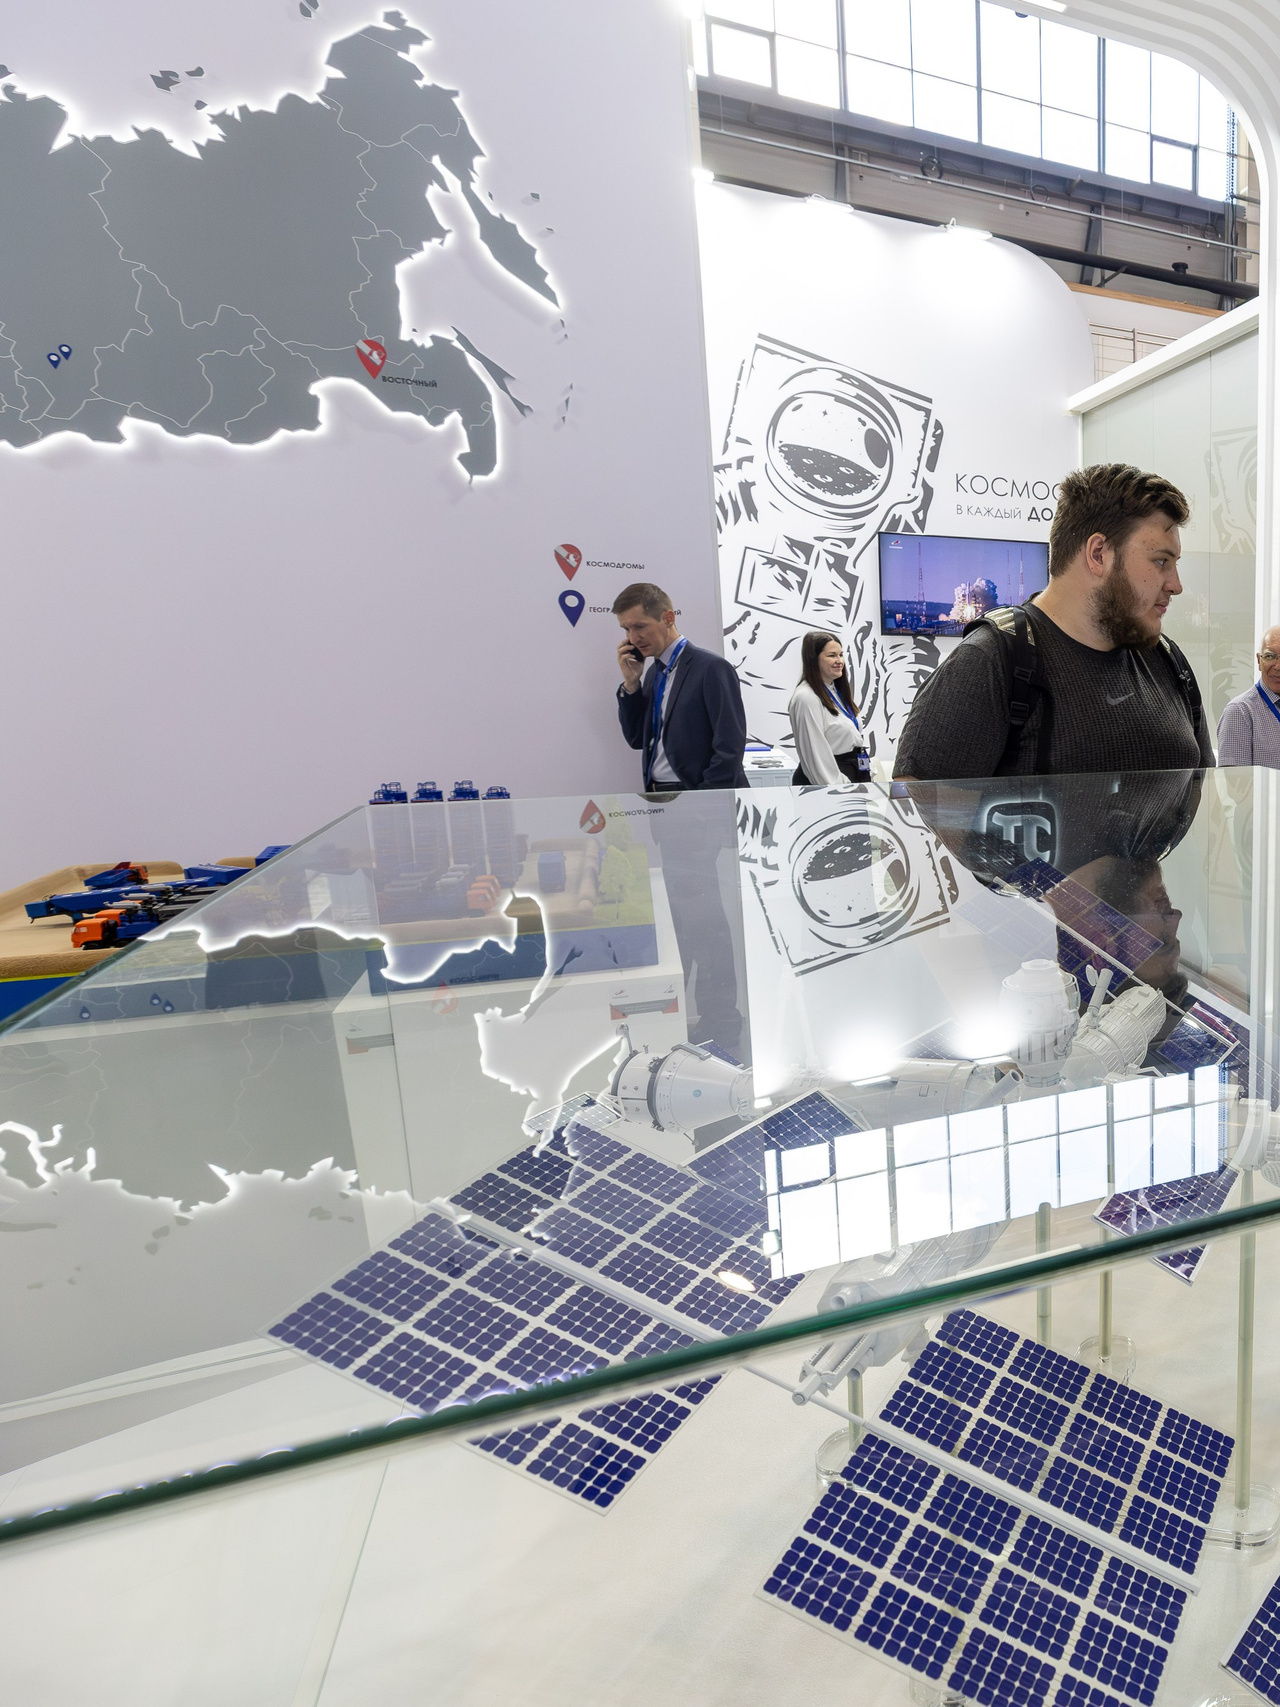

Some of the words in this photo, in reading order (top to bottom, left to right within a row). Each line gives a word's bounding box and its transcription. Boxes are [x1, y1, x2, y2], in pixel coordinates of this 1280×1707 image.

[381, 375, 438, 388] ВОСТОЧНЫЙ
[956, 504, 963, 515] В
[967, 505, 1022, 520] КАЖДЫЙ
[1027, 506, 1054, 522] ДО
[586, 560, 645, 570] КОСМОДРОМЫ
